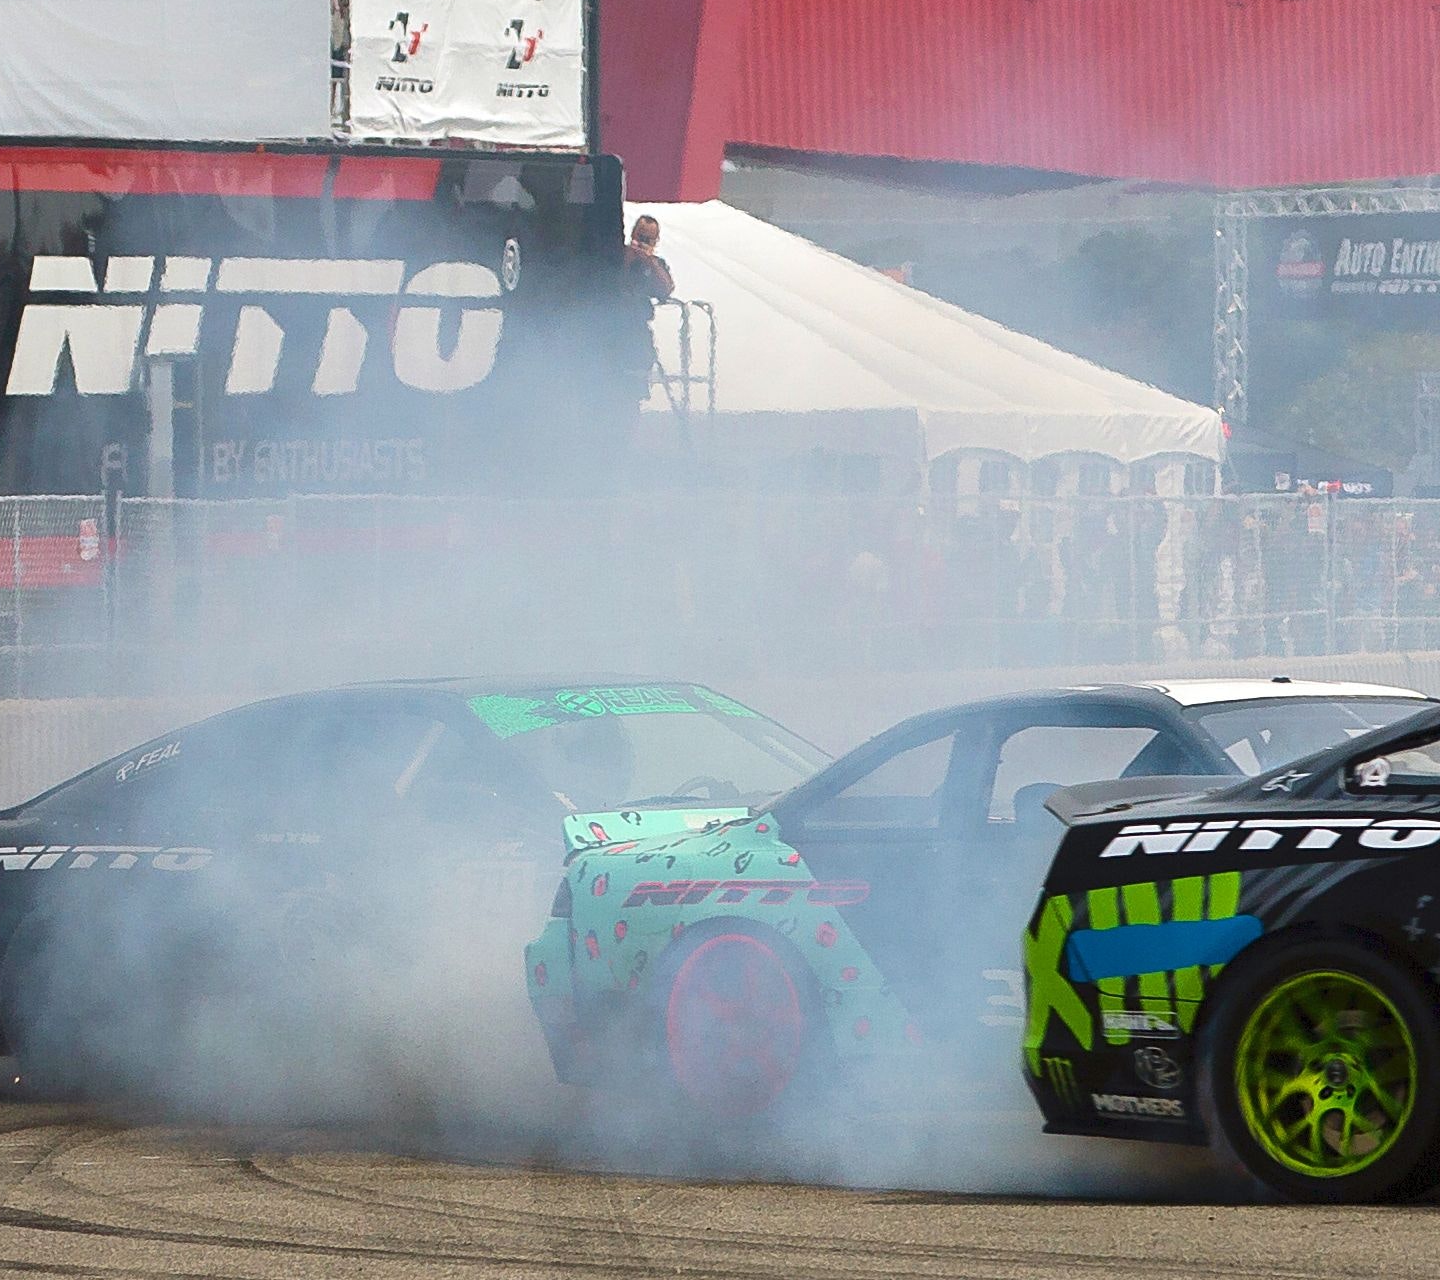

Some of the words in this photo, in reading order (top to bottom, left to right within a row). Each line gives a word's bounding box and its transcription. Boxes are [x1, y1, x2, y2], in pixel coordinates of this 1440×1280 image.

[375, 76, 433, 94] NITTO
[496, 82, 549, 99] NITTO
[1334, 238, 1386, 276] AUTO
[5, 255, 504, 396] NITTO
[621, 879, 871, 908] NITTO
